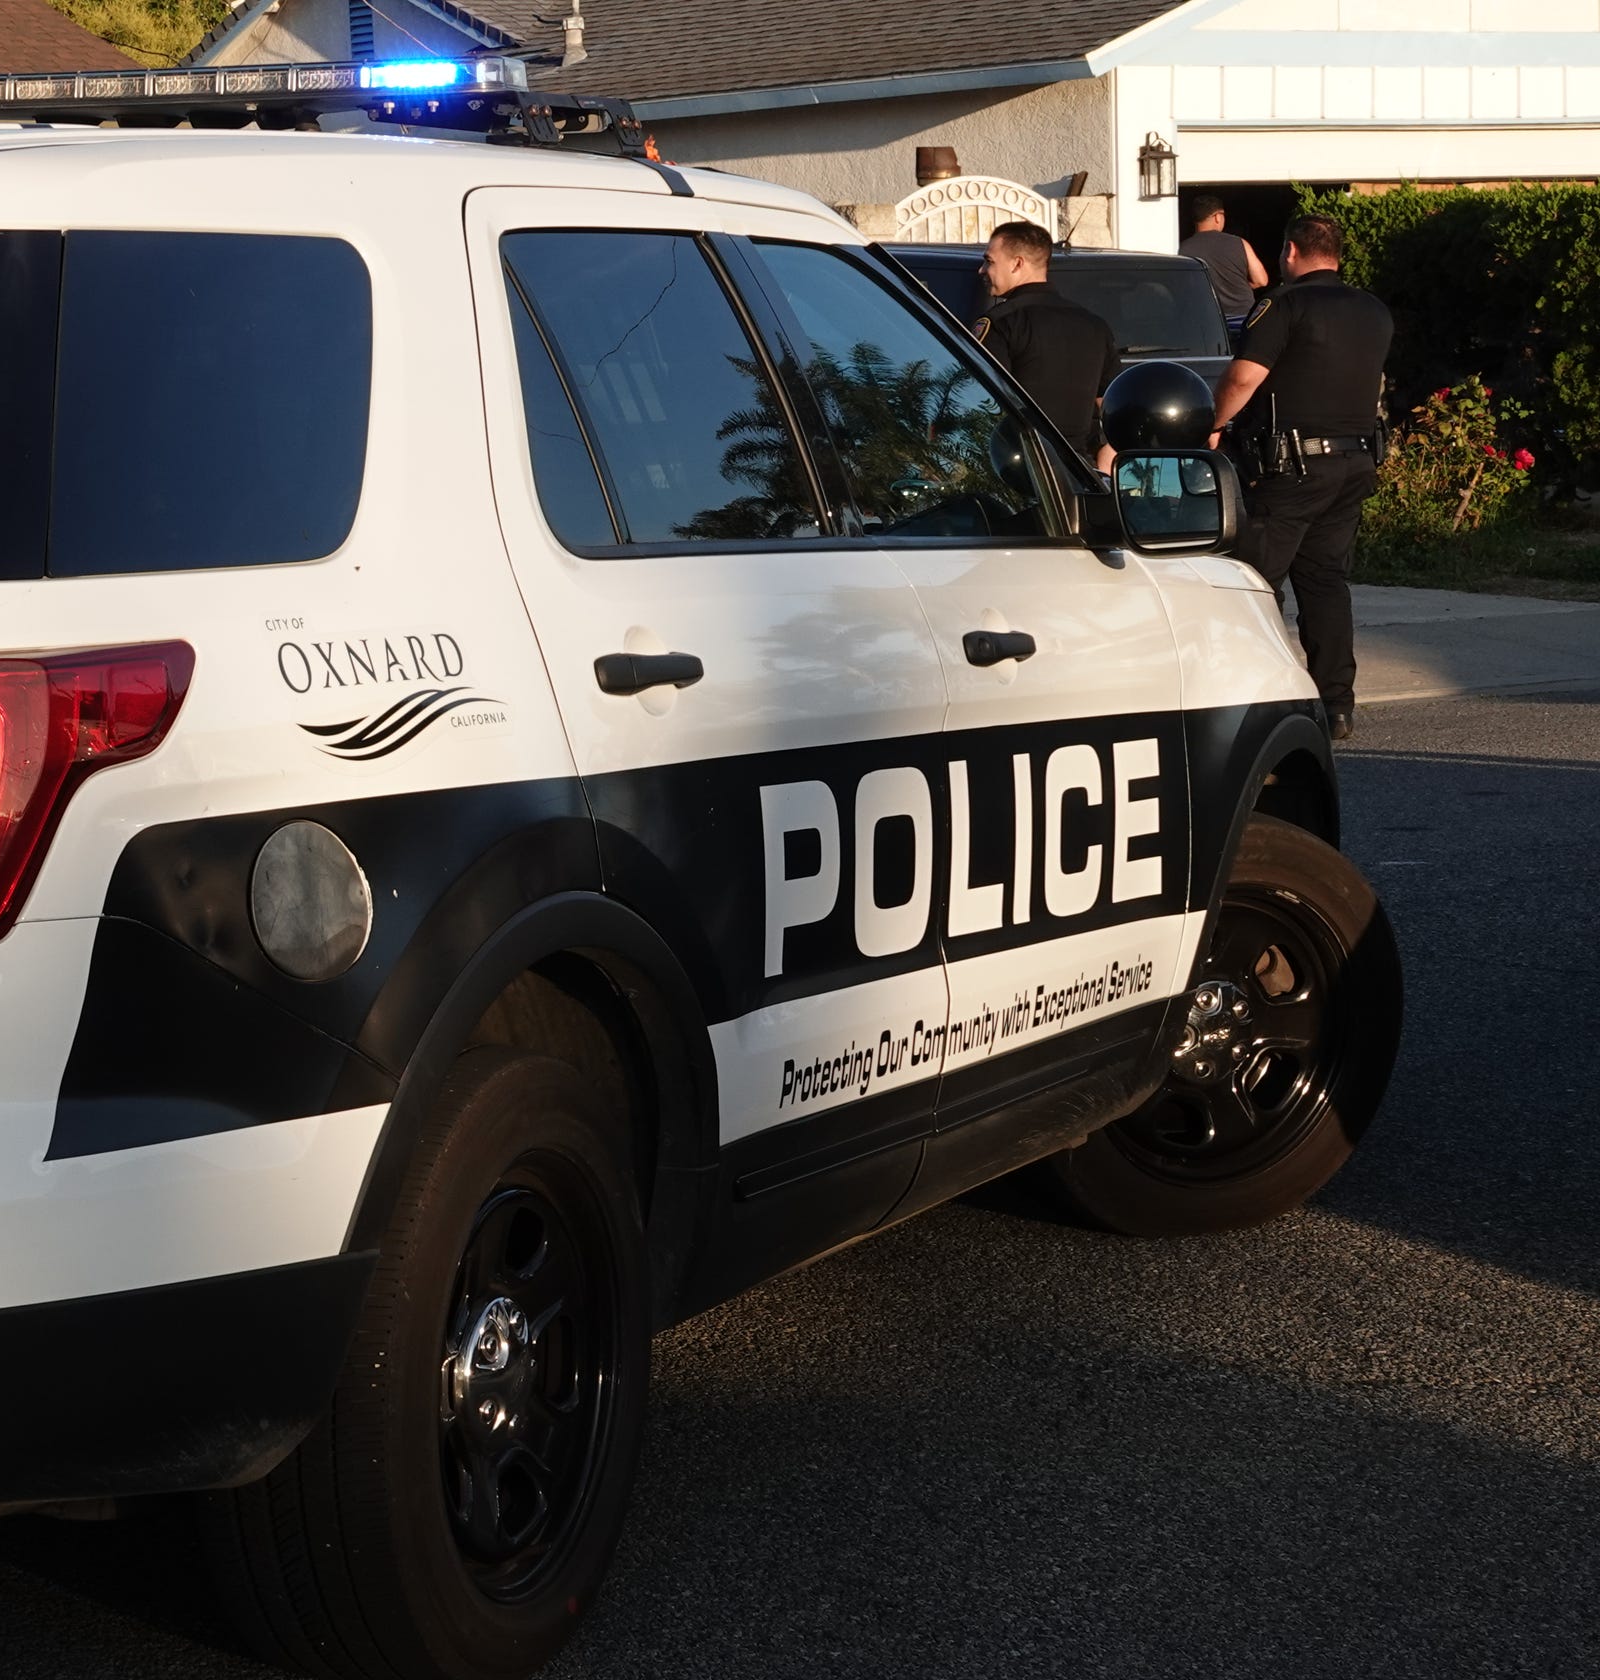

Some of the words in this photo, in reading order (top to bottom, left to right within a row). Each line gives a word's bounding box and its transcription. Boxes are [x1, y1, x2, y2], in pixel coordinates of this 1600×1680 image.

[265, 618, 289, 632] CITY
[291, 617, 304, 630] OF
[277, 633, 464, 694] OXNARD
[450, 711, 508, 728] CALIFORNIA
[759, 737, 1163, 979] POLICE
[779, 1040, 874, 1109] Protecting
[876, 1029, 908, 1078] Our
[911, 1002, 1000, 1067] Community
[1001, 990, 1031, 1039] with
[1032, 963, 1109, 1030] Exceptional
[1107, 953, 1153, 1003] Service
